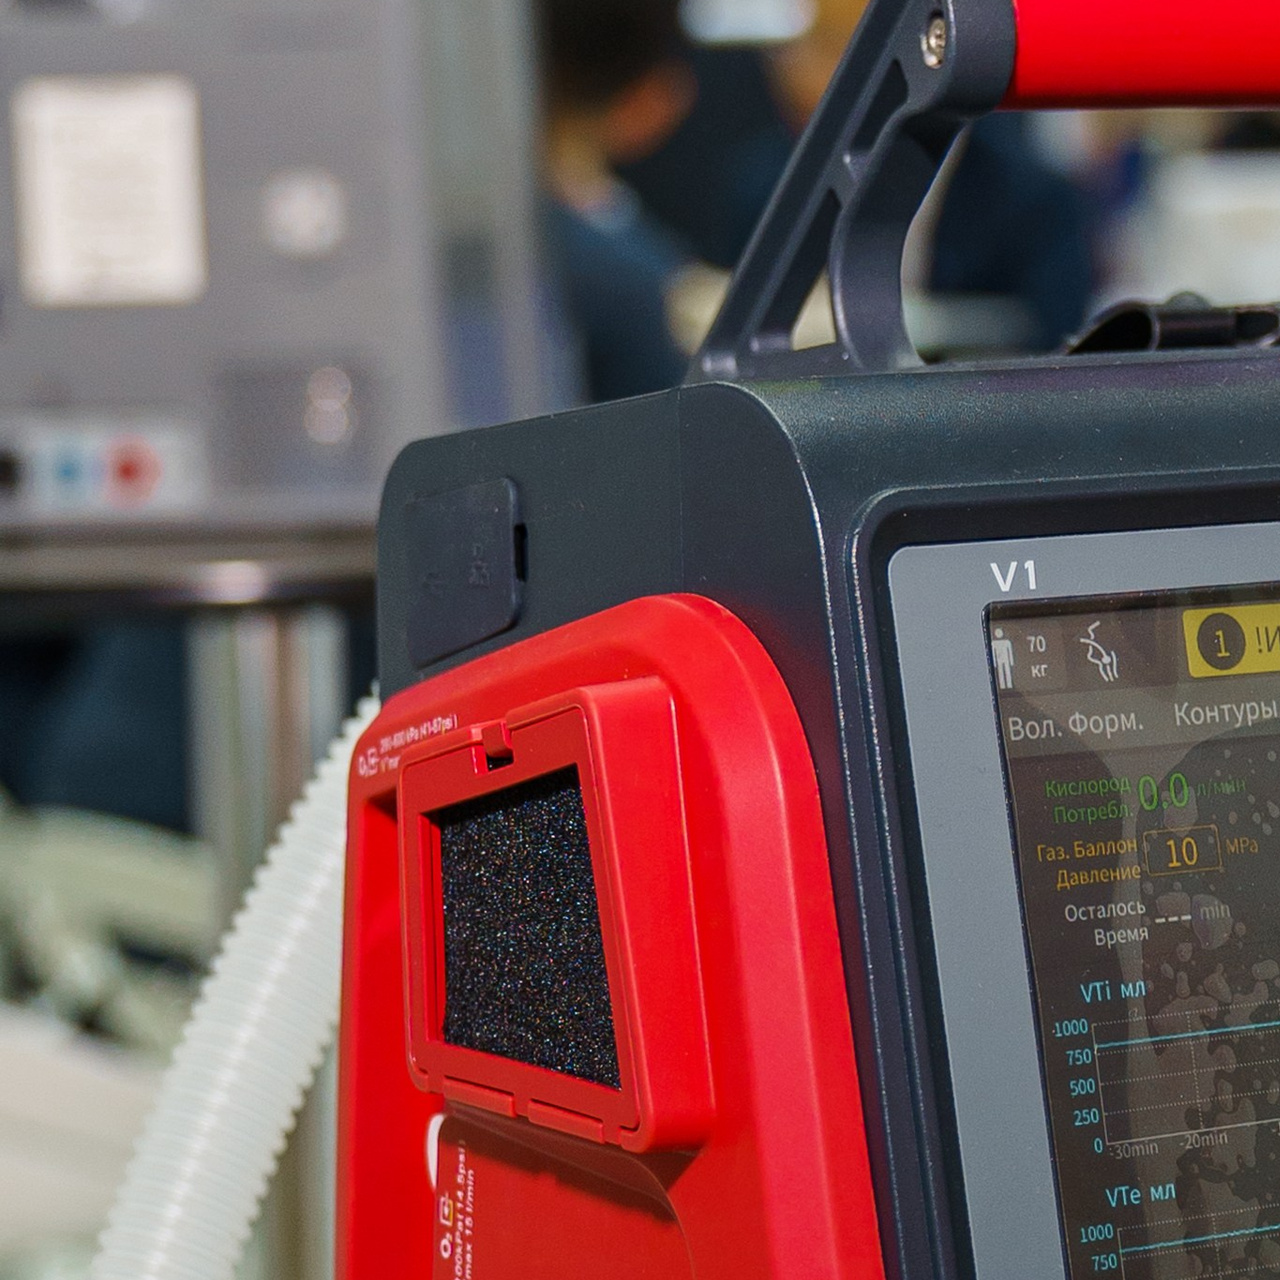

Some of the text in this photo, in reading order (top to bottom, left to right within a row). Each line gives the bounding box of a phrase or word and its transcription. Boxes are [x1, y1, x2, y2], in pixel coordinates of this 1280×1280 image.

[990, 560, 1037, 592] V1
[1027, 635, 1047, 654] 70
[1215, 629, 1231, 658] 1
[1009, 711, 1143, 741] Вол. Форм.
[1175, 700, 1278, 728] Контуры
[1045, 775, 1131, 800] Кислород
[1138, 773, 1190, 811] 0.0
[1054, 801, 1134, 825] Потребл.
[1037, 836, 1137, 863] Газ. Баллон
[1166, 837, 1258, 868] 10 MPa
[1056, 864, 1141, 891] Давление
[1064, 898, 1147, 923] Осталось
[1094, 923, 1149, 948] Время
[1081, 981, 1111, 1003] VTi
[1054, 1020, 1088, 1038] 1000
[1066, 1049, 1092, 1065] 750
[1070, 1079, 1095, 1095] 500
[1074, 1108, 1099, 1125] 250
[1094, 1139, 1102, 1153] 0
[1107, 1186, 1140, 1207] VTe
[1080, 1225, 1114, 1243] 1000
[1092, 1254, 1117, 1270] 750
